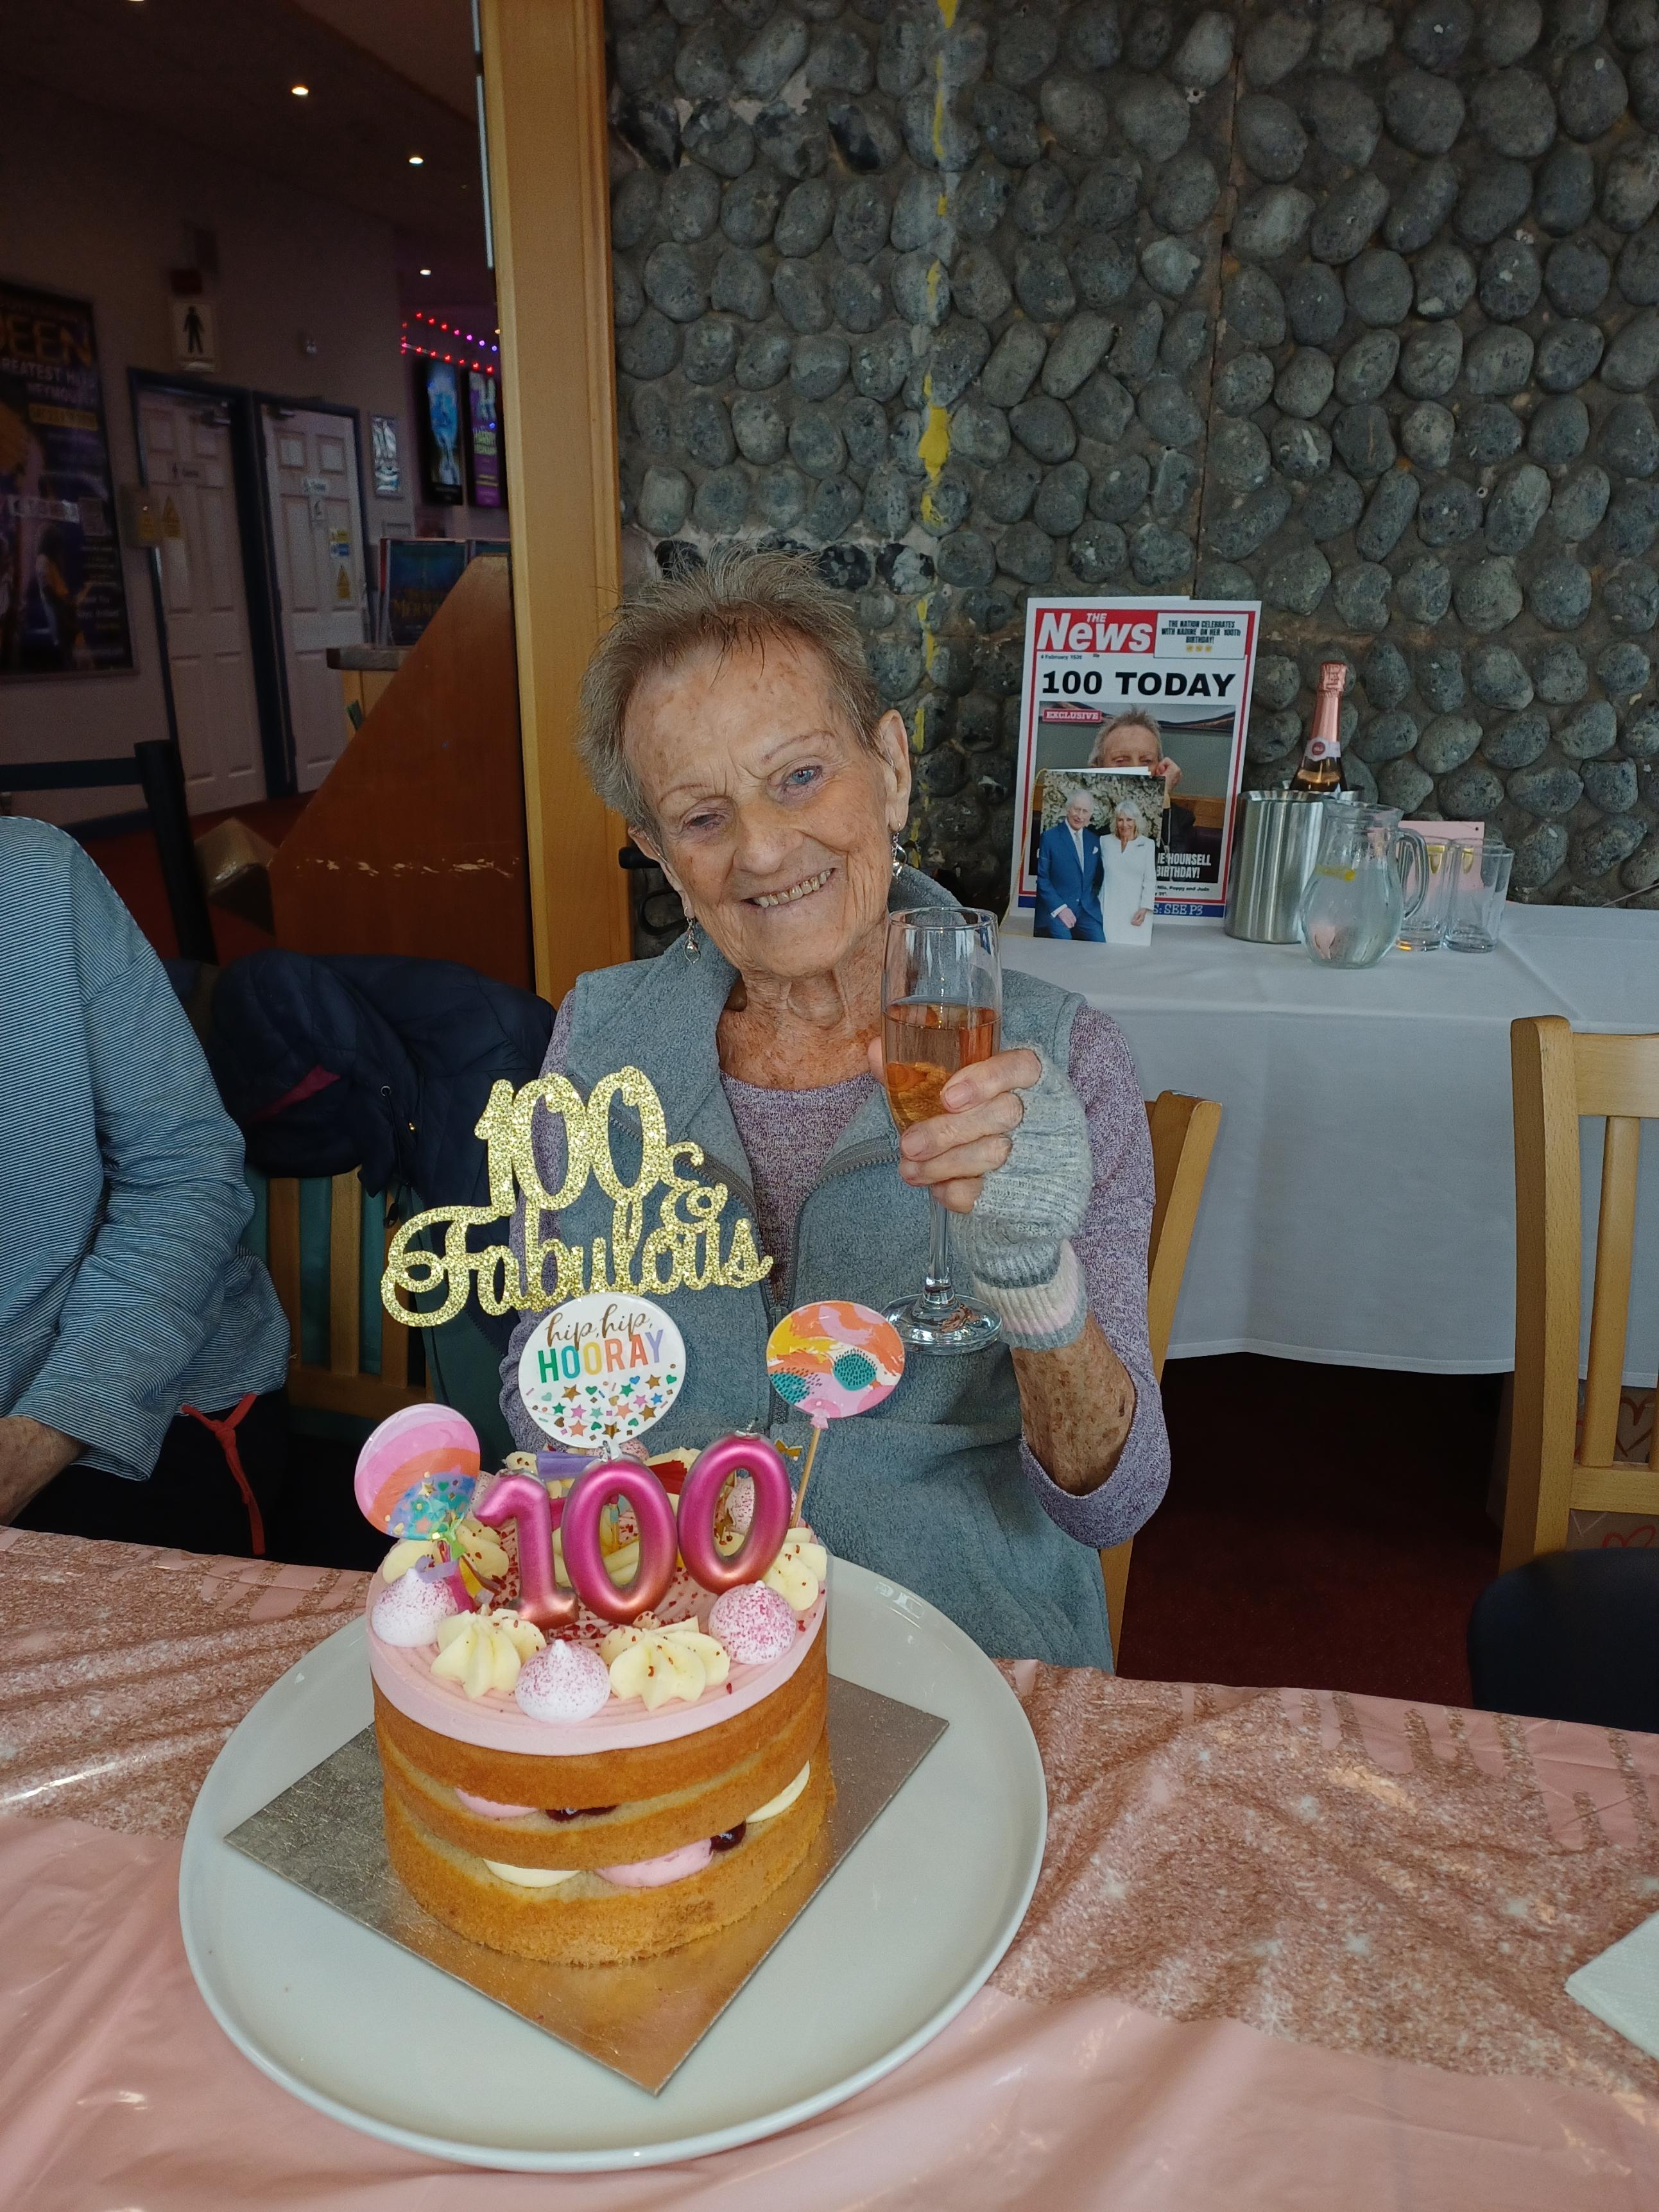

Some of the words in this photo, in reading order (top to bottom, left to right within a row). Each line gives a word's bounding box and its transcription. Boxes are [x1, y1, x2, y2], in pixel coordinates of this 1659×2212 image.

[1036, 612, 1153, 652] News
[1087, 613, 1108, 623] THE
[1042, 671, 1103, 694] 100
[1115, 672, 1236, 697] TODAY
[1046, 711, 1099, 719] EXCLUSIVE
[1168, 853, 1211, 866] HOUNSELL
[1164, 904, 1187, 914] SEE
[1189, 905, 1203, 915] P3
[474, 1065, 666, 1215] 100
[659, 1142, 728, 1230] &
[381, 1196, 773, 1326] Fabulous
[538, 1329, 664, 1383] HOORAY
[474, 1432, 792, 1631] 100
